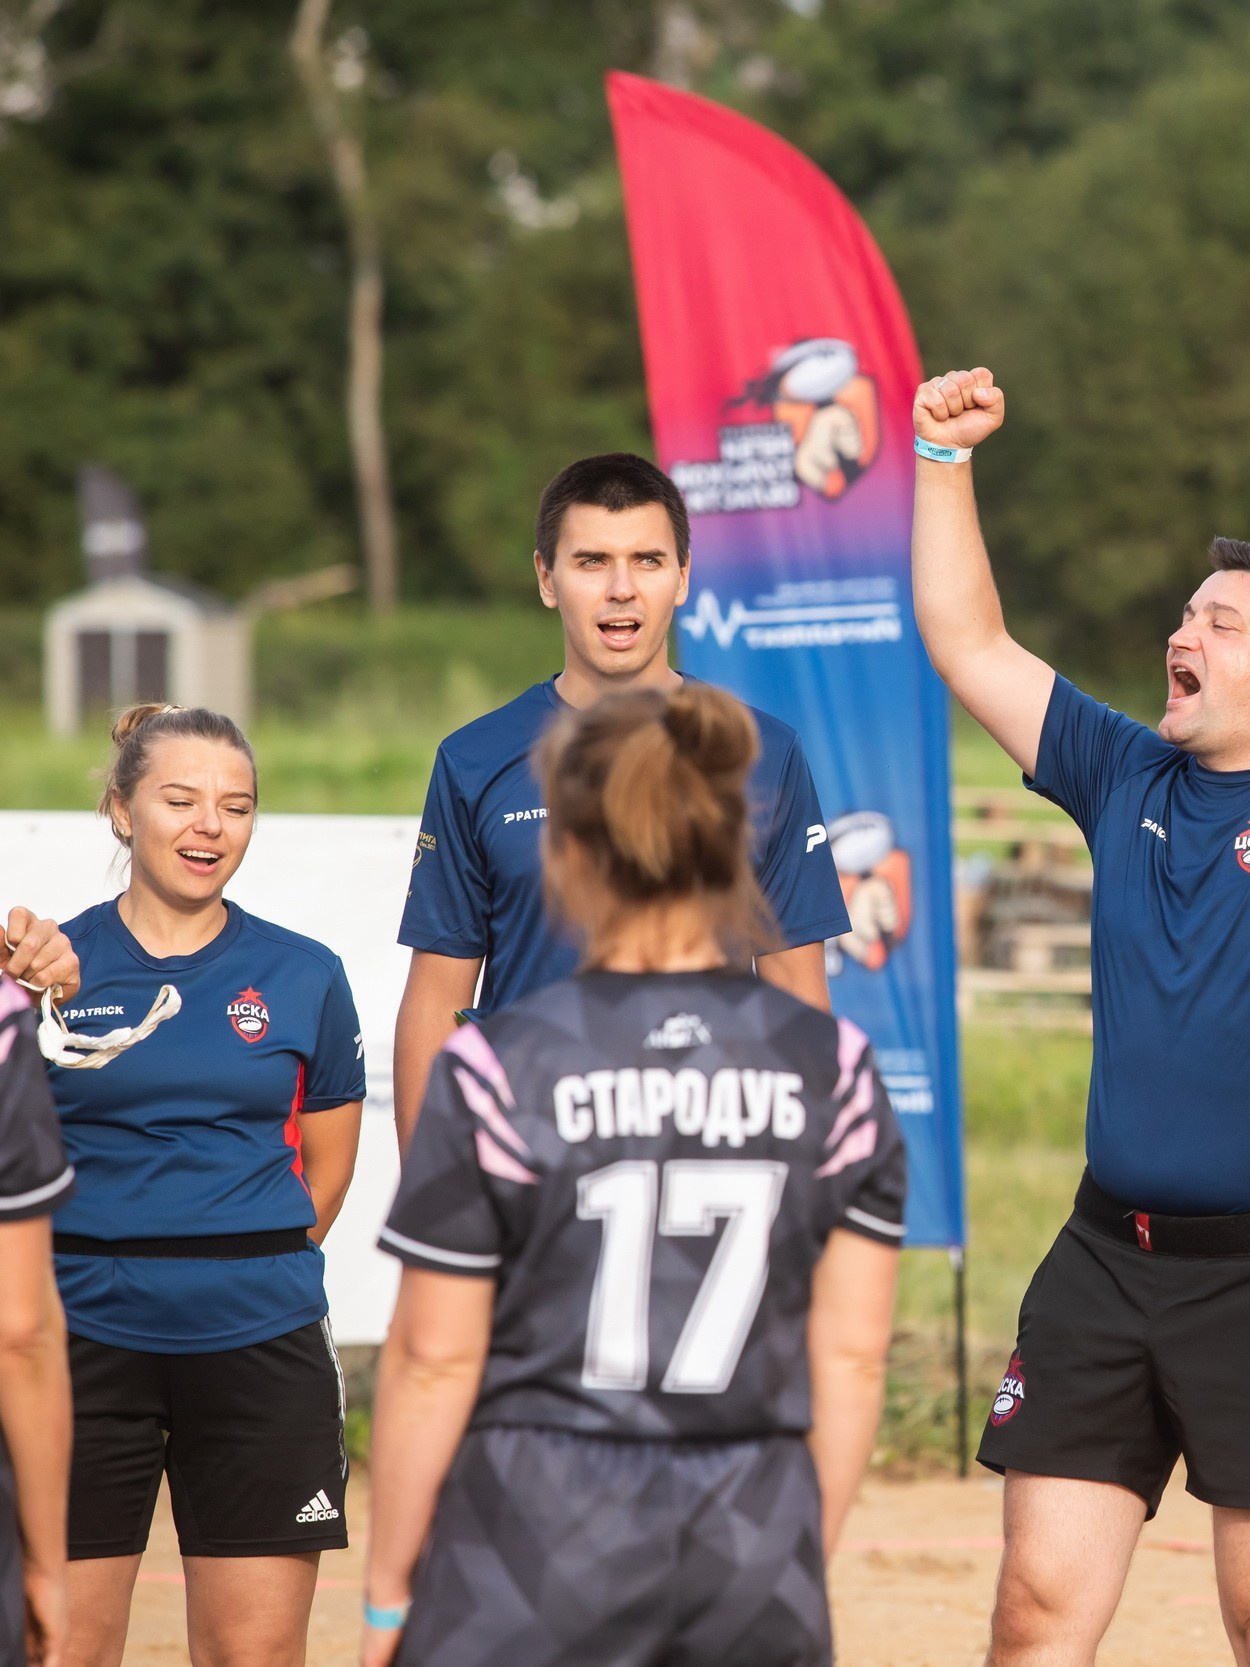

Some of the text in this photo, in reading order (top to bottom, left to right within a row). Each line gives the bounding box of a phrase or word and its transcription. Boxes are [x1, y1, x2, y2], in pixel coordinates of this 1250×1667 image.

[69, 1005, 125, 1020] PATRICK
[226, 1003, 270, 1023] ЦСКА
[553, 1067, 806, 1147] СТАРОДУБ
[576, 1158, 790, 1394] 17
[295, 1508, 340, 1523] adidas
